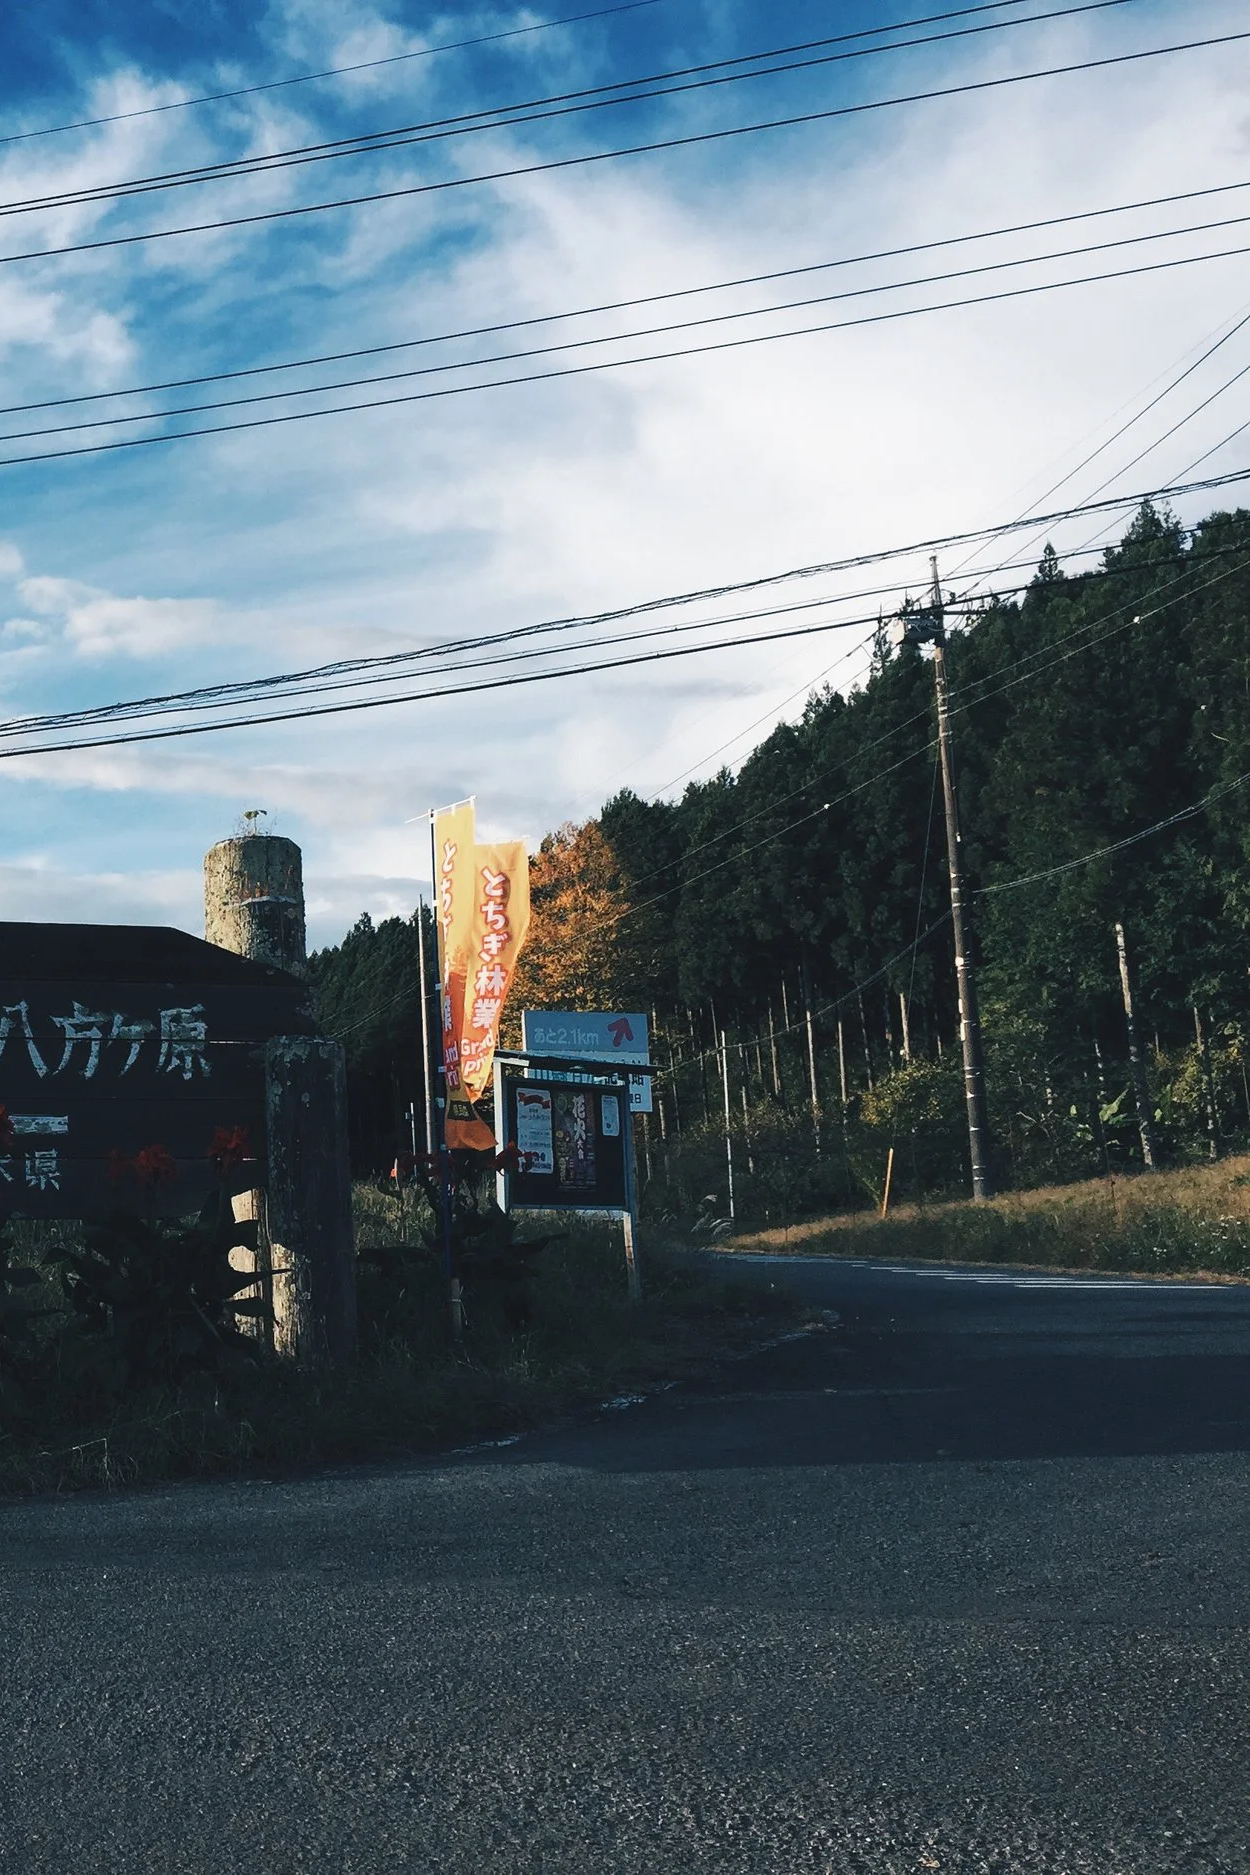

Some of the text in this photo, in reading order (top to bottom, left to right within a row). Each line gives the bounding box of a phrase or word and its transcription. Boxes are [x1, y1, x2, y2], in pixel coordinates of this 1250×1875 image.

[471, 869, 507, 1029] とちぎ林業
